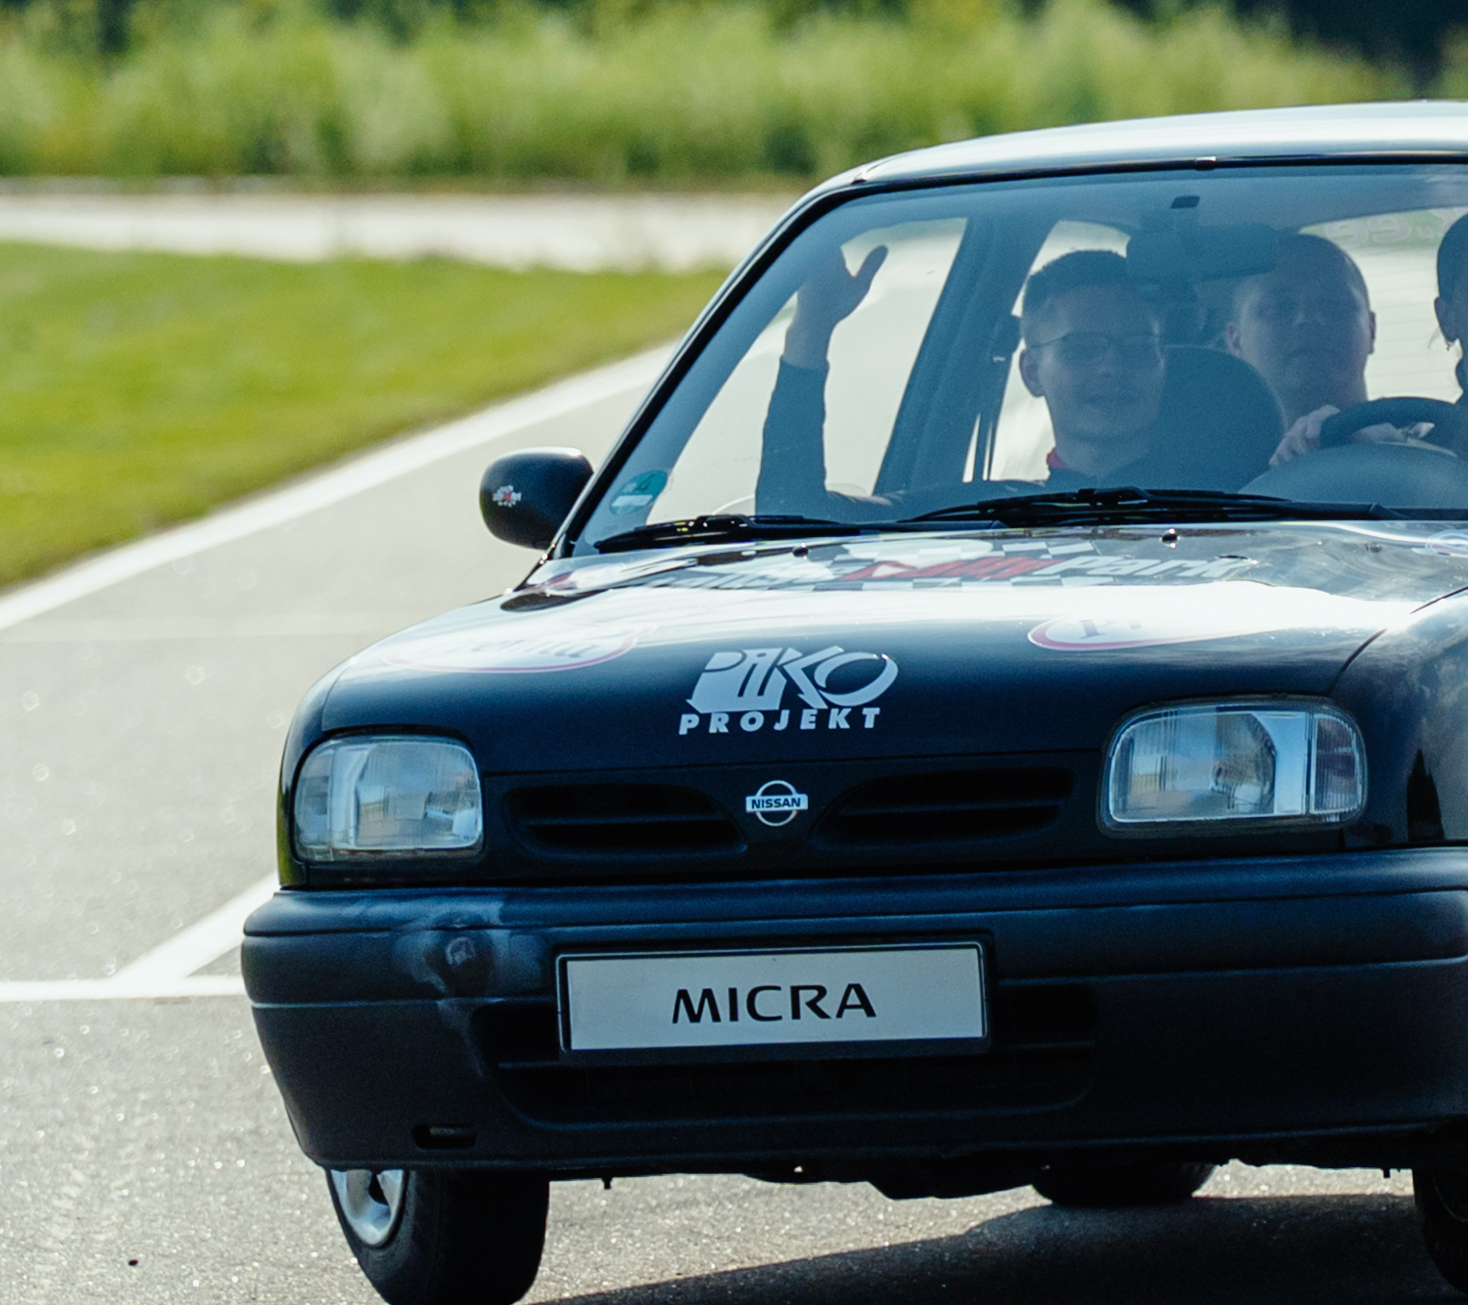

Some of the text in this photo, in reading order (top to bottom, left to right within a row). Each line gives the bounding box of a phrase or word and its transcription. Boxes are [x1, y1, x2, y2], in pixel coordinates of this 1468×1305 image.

[678, 707, 881, 735] PROJEKT
[751, 797, 801, 810] NISSAN
[672, 982, 877, 1024] MICRA
